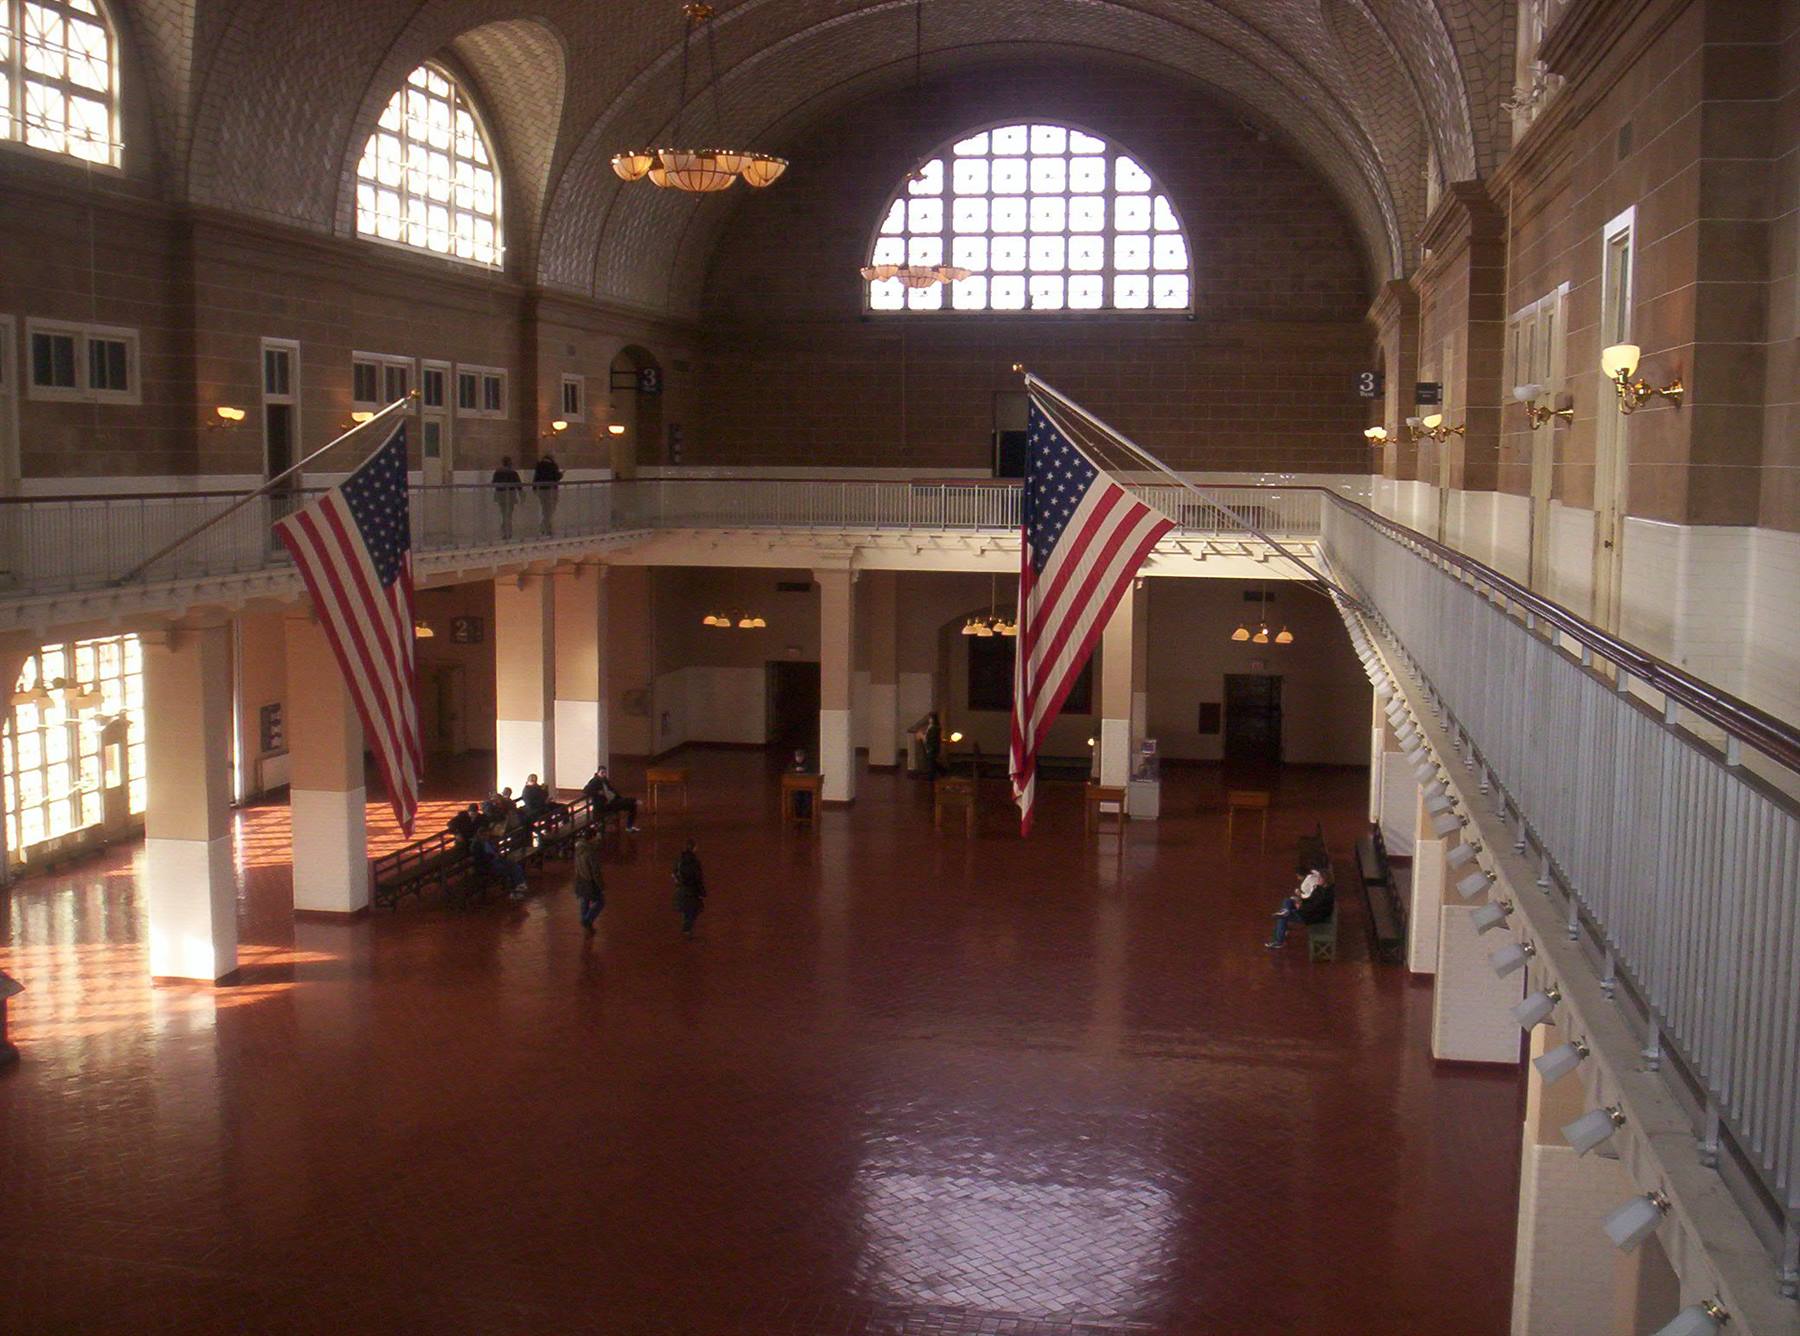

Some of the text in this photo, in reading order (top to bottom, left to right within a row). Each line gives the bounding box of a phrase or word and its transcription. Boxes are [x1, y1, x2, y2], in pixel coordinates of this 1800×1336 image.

[643, 368, 656, 386] 3
[1360, 372, 1374, 392] 3
[455, 619, 467, 637] 2
